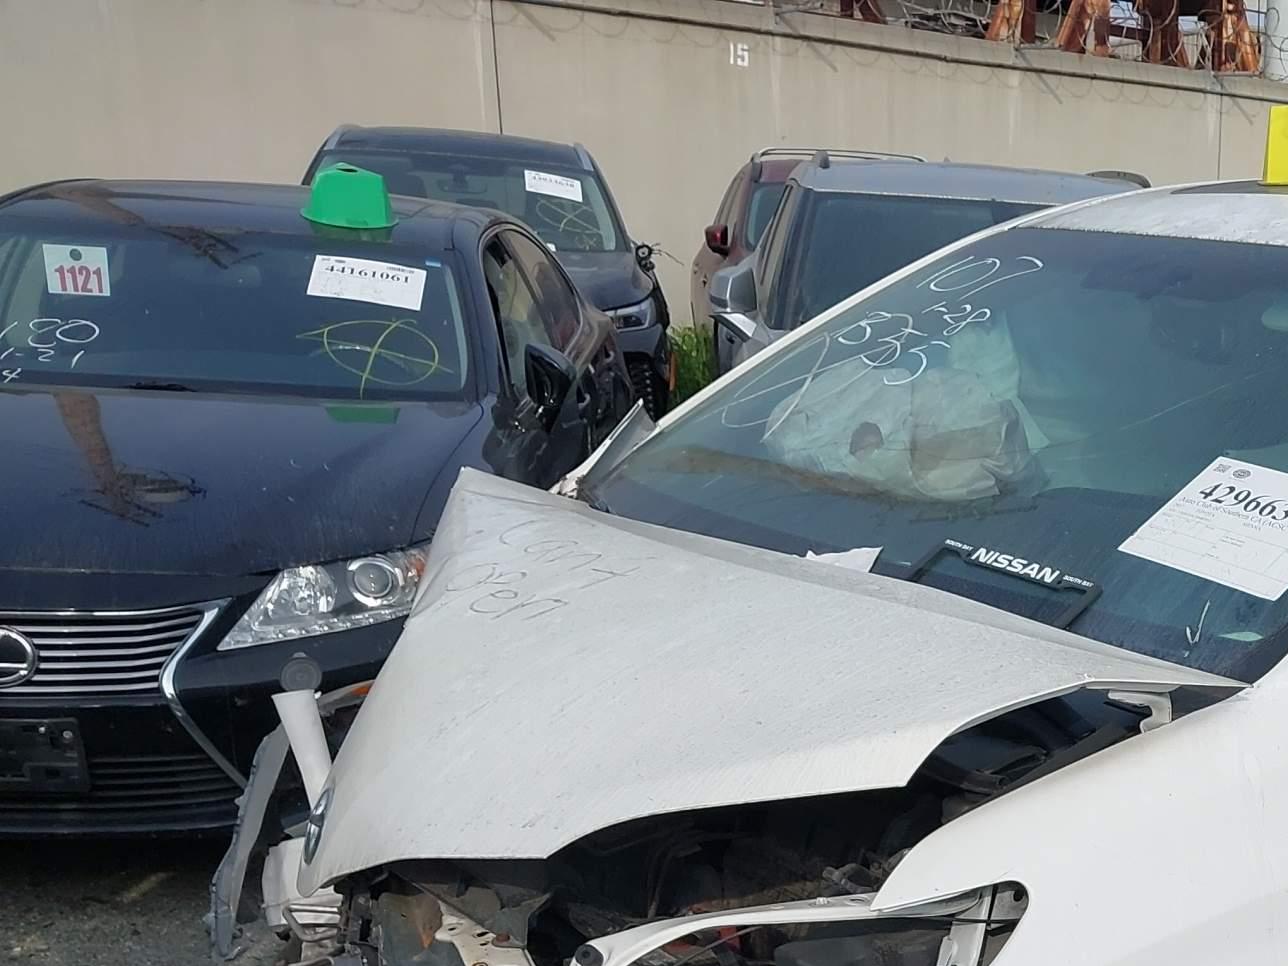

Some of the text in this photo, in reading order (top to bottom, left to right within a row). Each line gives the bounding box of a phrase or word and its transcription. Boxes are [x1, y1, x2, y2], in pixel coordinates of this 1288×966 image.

[730, 42, 749, 67] 15
[54, 265, 104, 293] 1121
[325, 265, 409, 283] 44161061
[970, 547, 1061, 583] NISSAN
